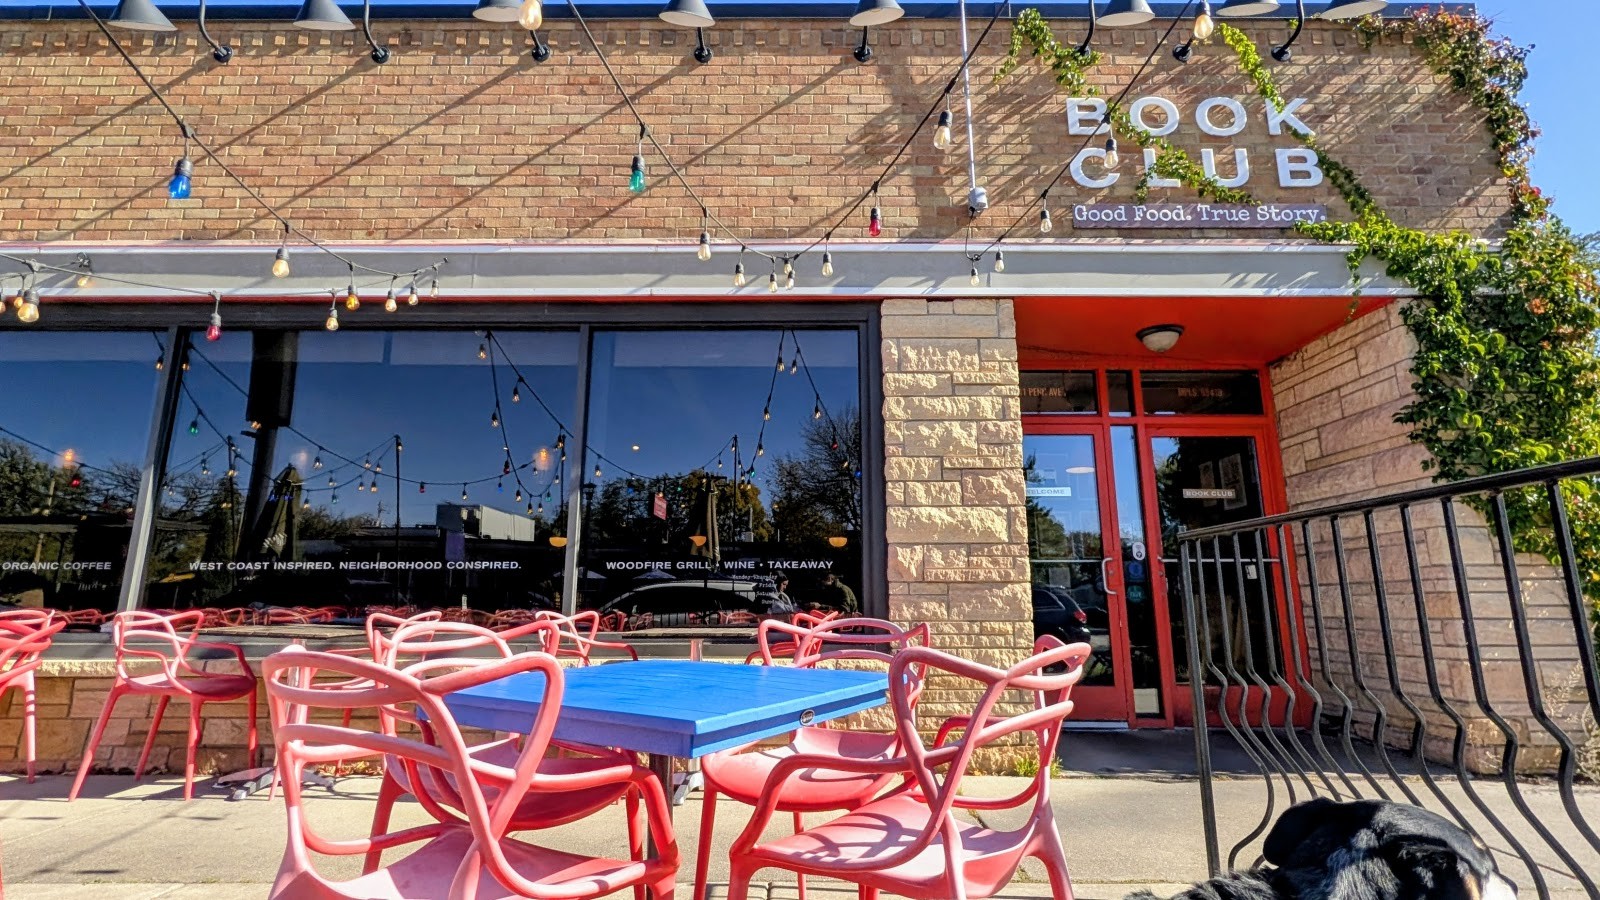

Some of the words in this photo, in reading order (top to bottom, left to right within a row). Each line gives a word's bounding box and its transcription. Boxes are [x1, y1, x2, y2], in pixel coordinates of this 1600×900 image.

[1066, 96, 1316, 137] BOOK
[1069, 148, 1324, 189] CLUB
[1074, 205, 1128, 222] Good
[1133, 205, 1192, 222] Food.
[1197, 205, 1250, 222] True
[1256, 205, 1327, 226] Story.
[2, 562, 59, 570] ORGANIC
[63, 562, 112, 570] COFFEE
[189, 562, 223, 570] WEST
[227, 562, 269, 570] COAST
[273, 562, 335, 570] INSPIRED.
[339, 561, 442, 570] NEIGHBORHOOD
[446, 561, 522, 570] CONSPIRED.
[606, 561, 672, 570] WOODFIRE
[676, 561, 712, 570] GRILL
[724, 561, 755, 569] WINE
[767, 560, 834, 569] TAKEAWAY
